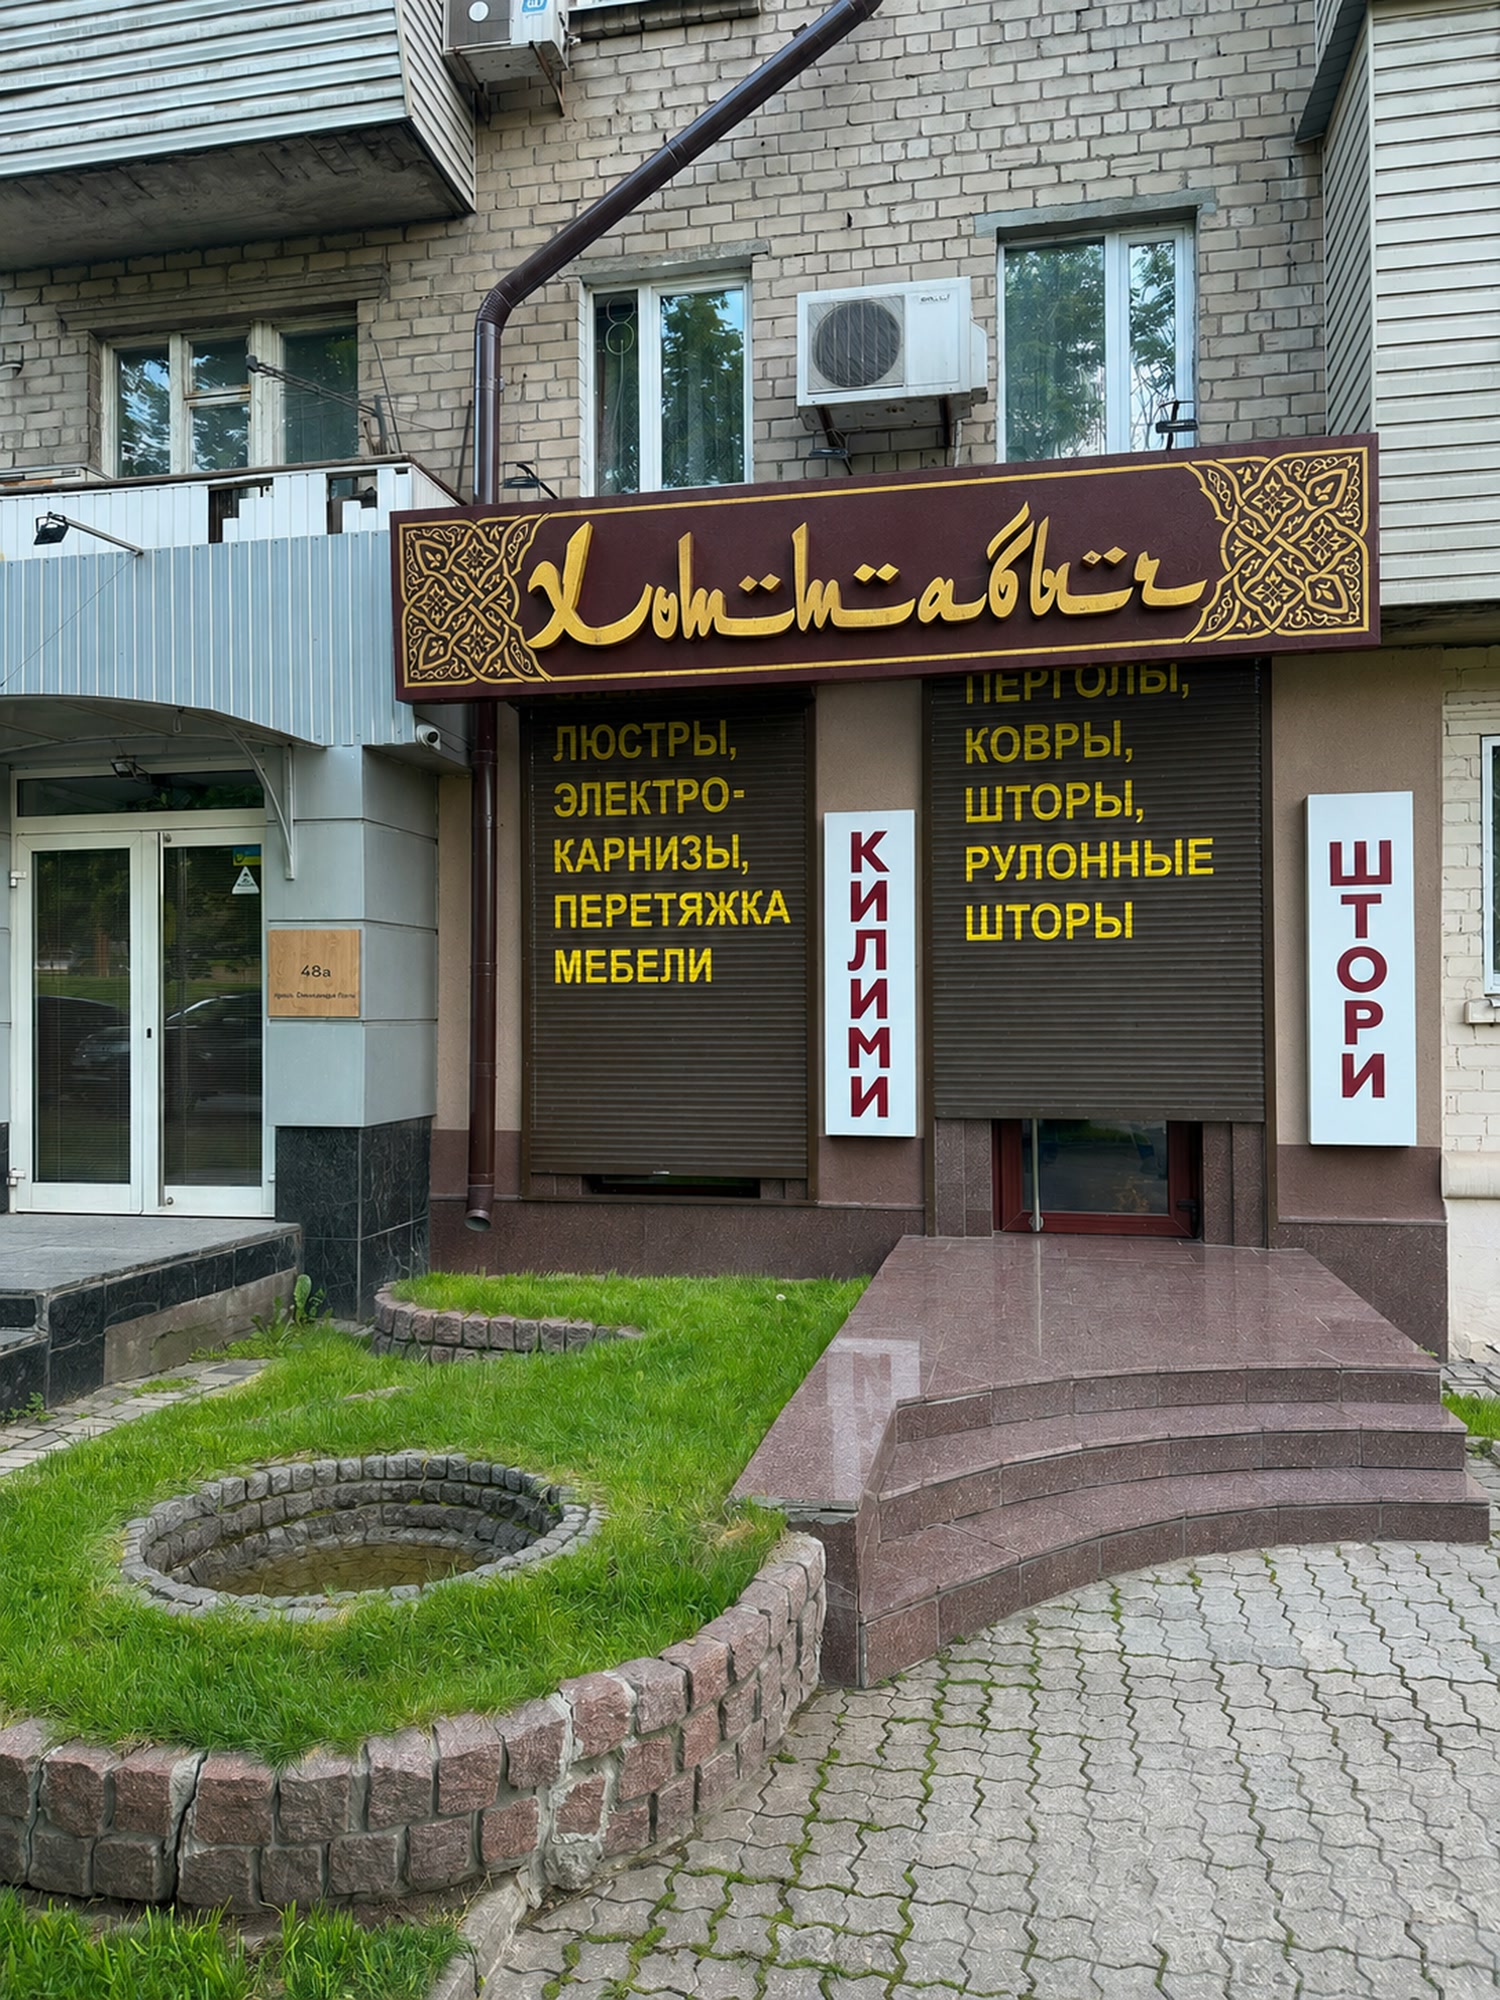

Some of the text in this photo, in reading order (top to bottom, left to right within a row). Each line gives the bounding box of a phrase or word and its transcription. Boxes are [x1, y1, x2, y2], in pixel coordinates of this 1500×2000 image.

[526, 501, 1208, 650] Хоттабыч
[966, 663, 1189, 704] ПЕРГОЛЫ,
[553, 719, 737, 762] ЛЮСТРЫ,
[965, 720, 1133, 764] КОВРЫ,
[553, 777, 745, 817] ЭЛЕКТРО-
[965, 780, 1144, 823] ШТОРЫ,
[554, 834, 748, 875] КАРНИЗЫ,
[965, 838, 1214, 882] РУЛОННЫЕ
[554, 890, 791, 928] ПЕРЕТЯЖКА
[965, 901, 1133, 941] ШТОРЫ
[554, 948, 712, 984] МЕБЕЛИ
[847, 831, 890, 1118] КИЛИМИ
[1329, 840, 1392, 1098] ШТОРИ
